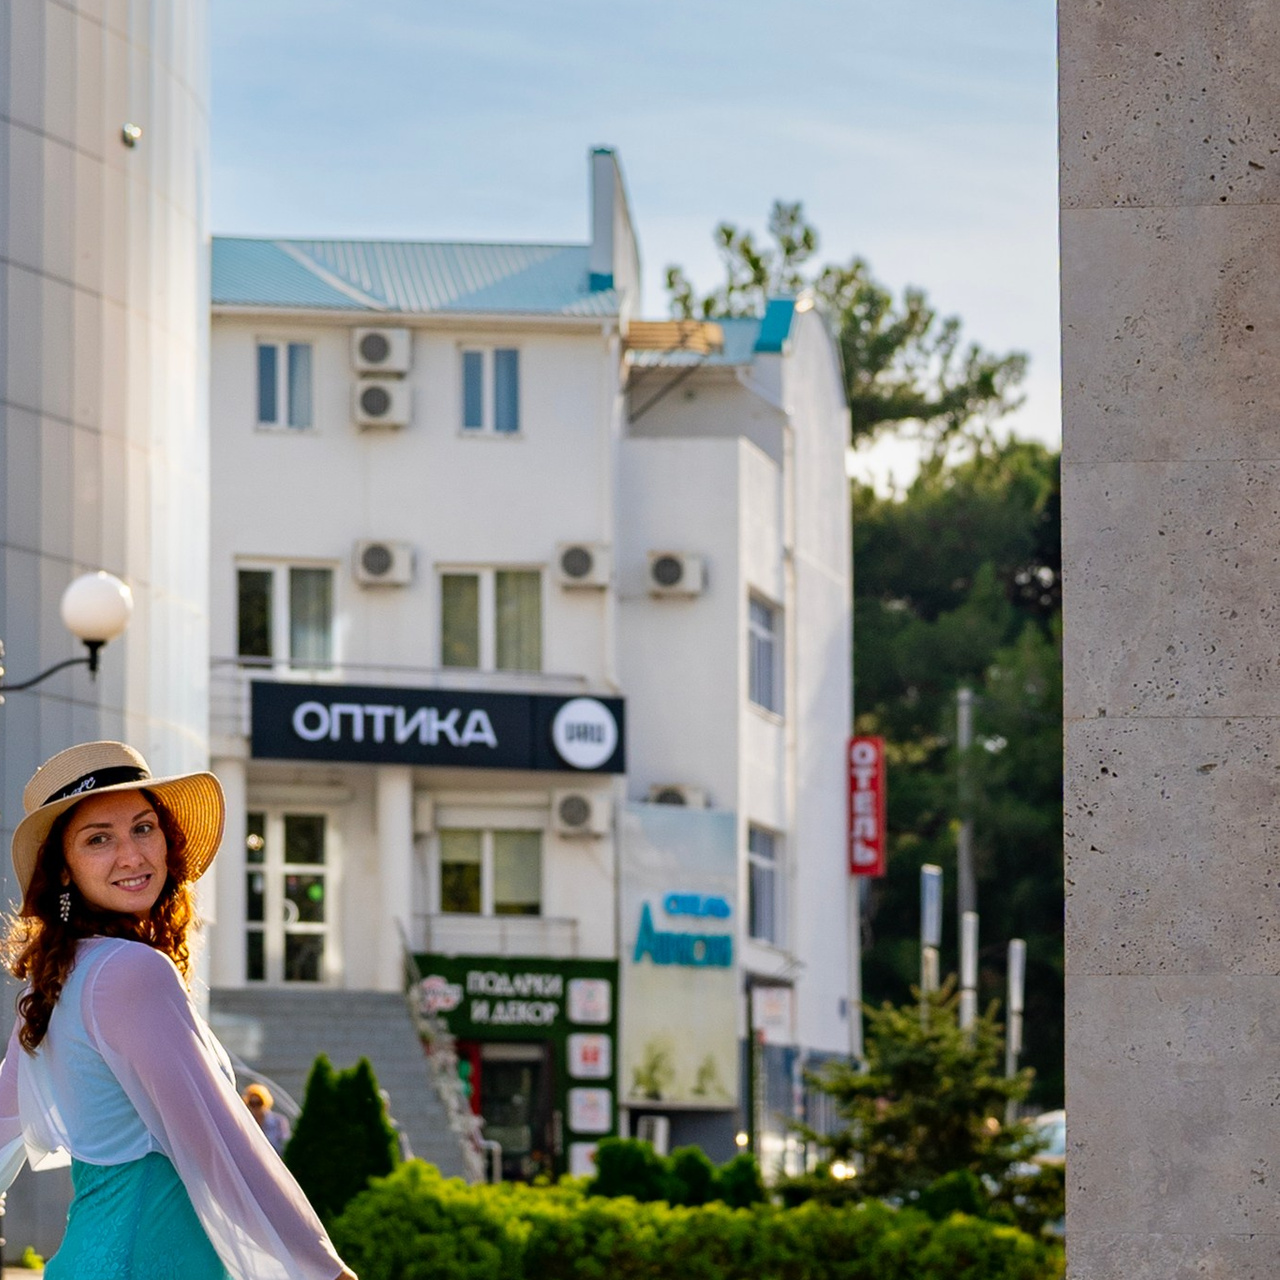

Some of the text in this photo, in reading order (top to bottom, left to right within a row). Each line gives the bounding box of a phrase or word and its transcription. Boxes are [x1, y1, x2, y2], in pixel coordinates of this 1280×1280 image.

[292, 700, 498, 748] ОПТИКА
[851, 741, 877, 866] ОТЕЛЬ
[466, 970, 563, 998] ПОДАРКИ
[471, 1000, 559, 1026] И ДЕКОР
